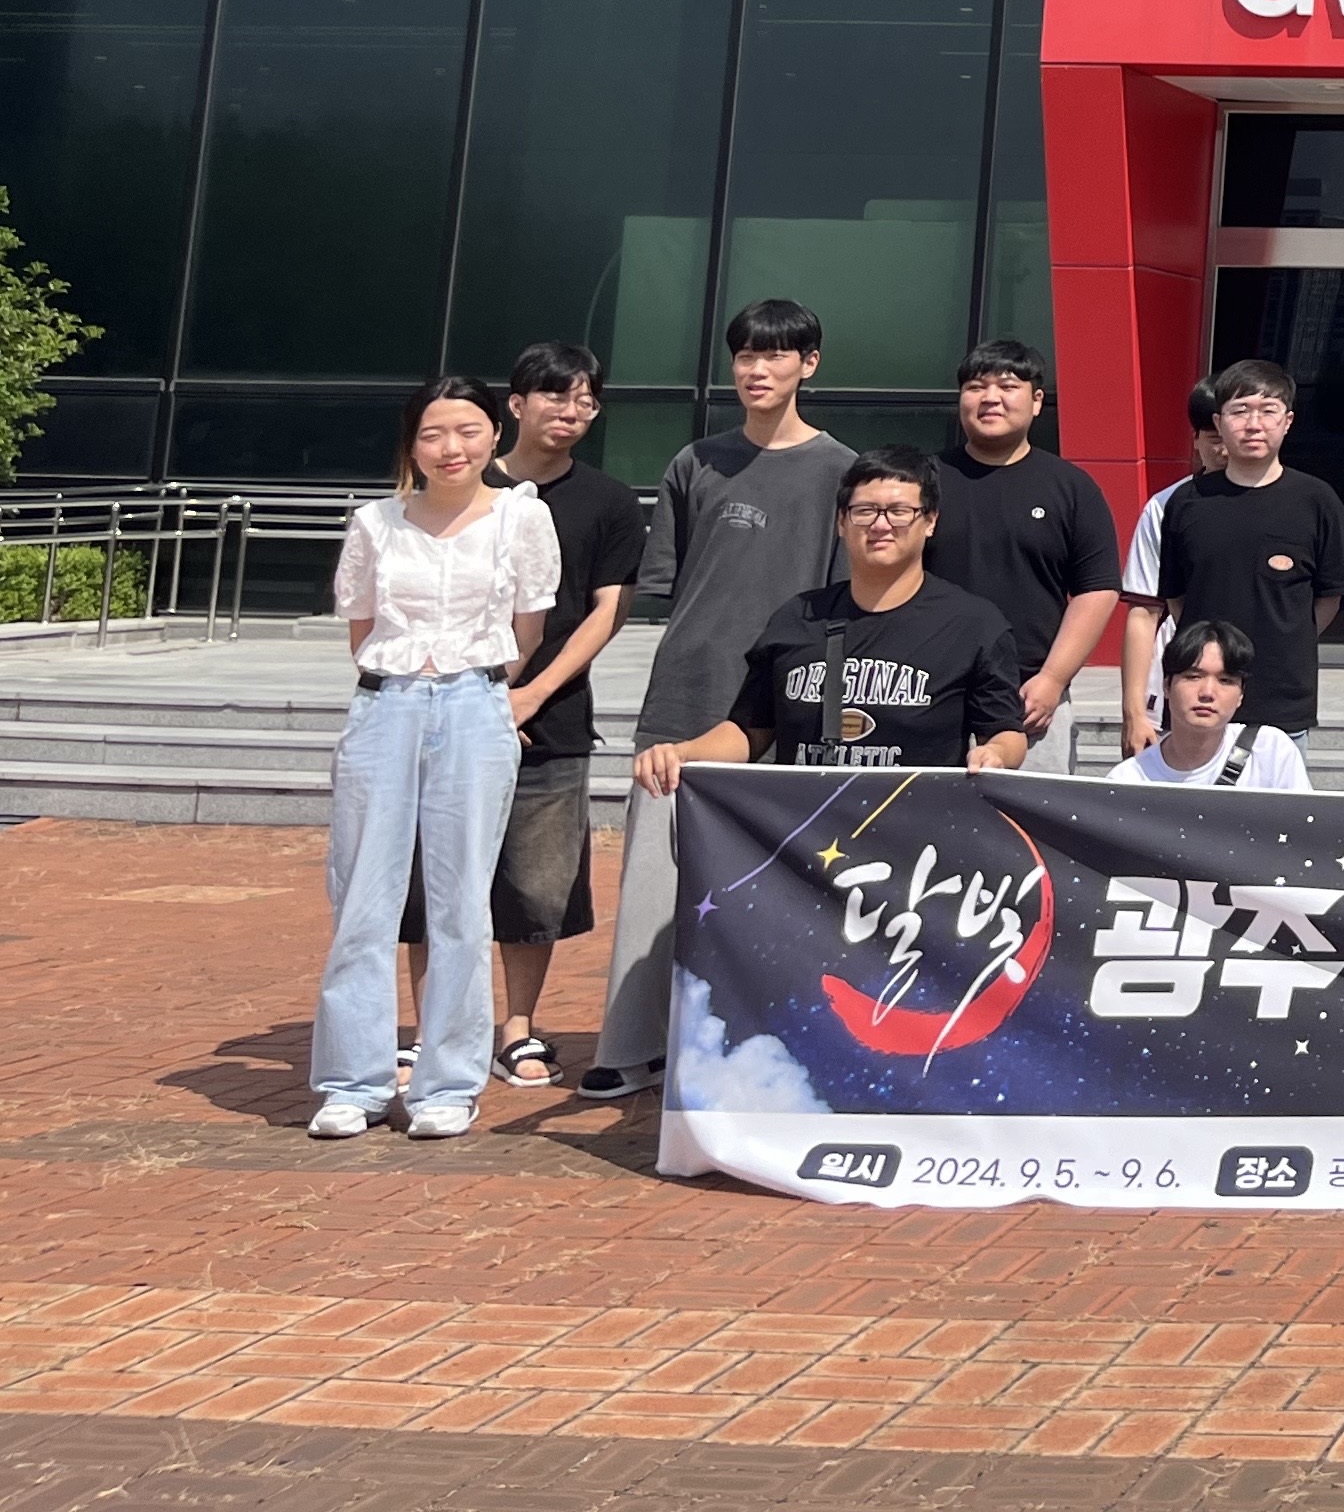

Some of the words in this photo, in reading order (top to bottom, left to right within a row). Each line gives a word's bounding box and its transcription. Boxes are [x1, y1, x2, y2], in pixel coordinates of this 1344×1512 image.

[785, 658, 931, 706] ORGINAL
[833, 844, 1046, 1078] 달빛
[912, 1157, 1006, 1188] 2024.
[1020, 1158, 1042, 1188] 9.
[1053, 1158, 1081, 1188] 5.
[1121, 1158, 1144, 1188] 9.
[1155, 1158, 1181, 1188] 6.
[1235, 1156, 1298, 1189] 장소
